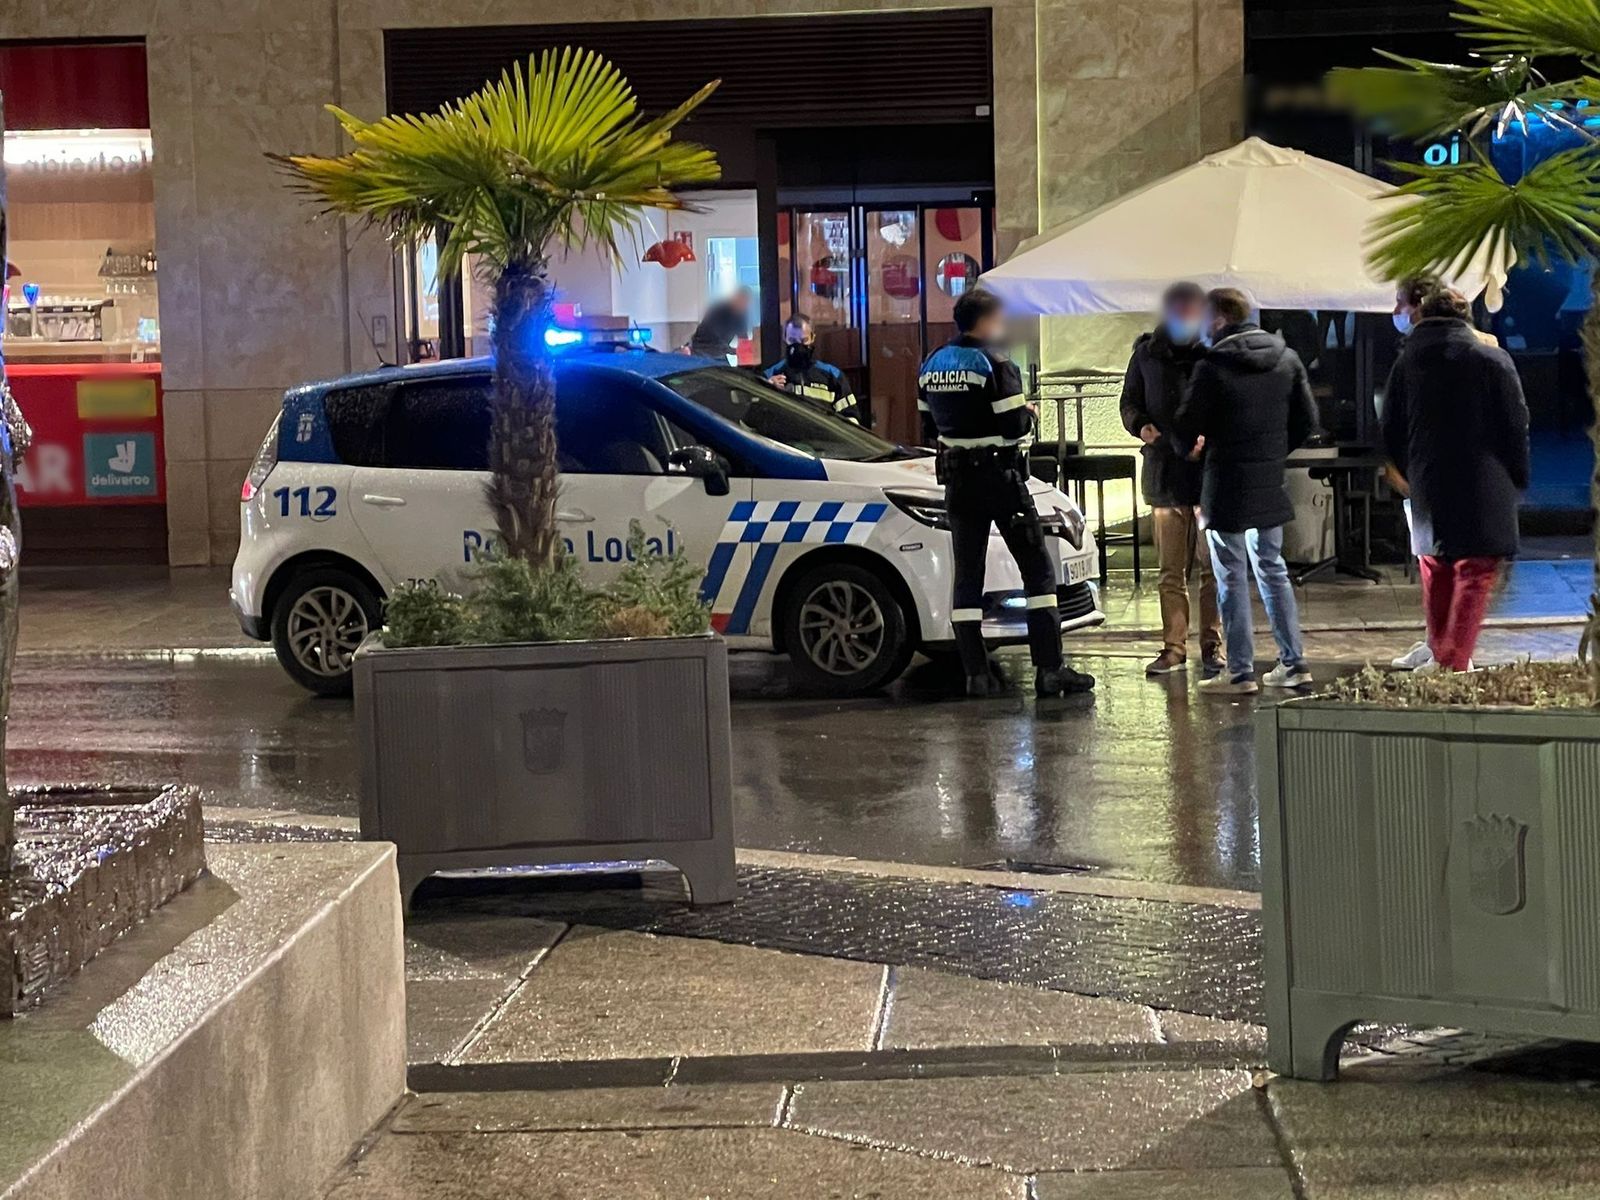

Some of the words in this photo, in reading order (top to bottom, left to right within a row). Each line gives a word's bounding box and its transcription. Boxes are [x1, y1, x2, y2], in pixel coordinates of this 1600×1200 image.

[926, 370, 967, 384] POLICIA
[91, 474, 150, 487] deliveroo
[273, 485, 337, 517] 112
